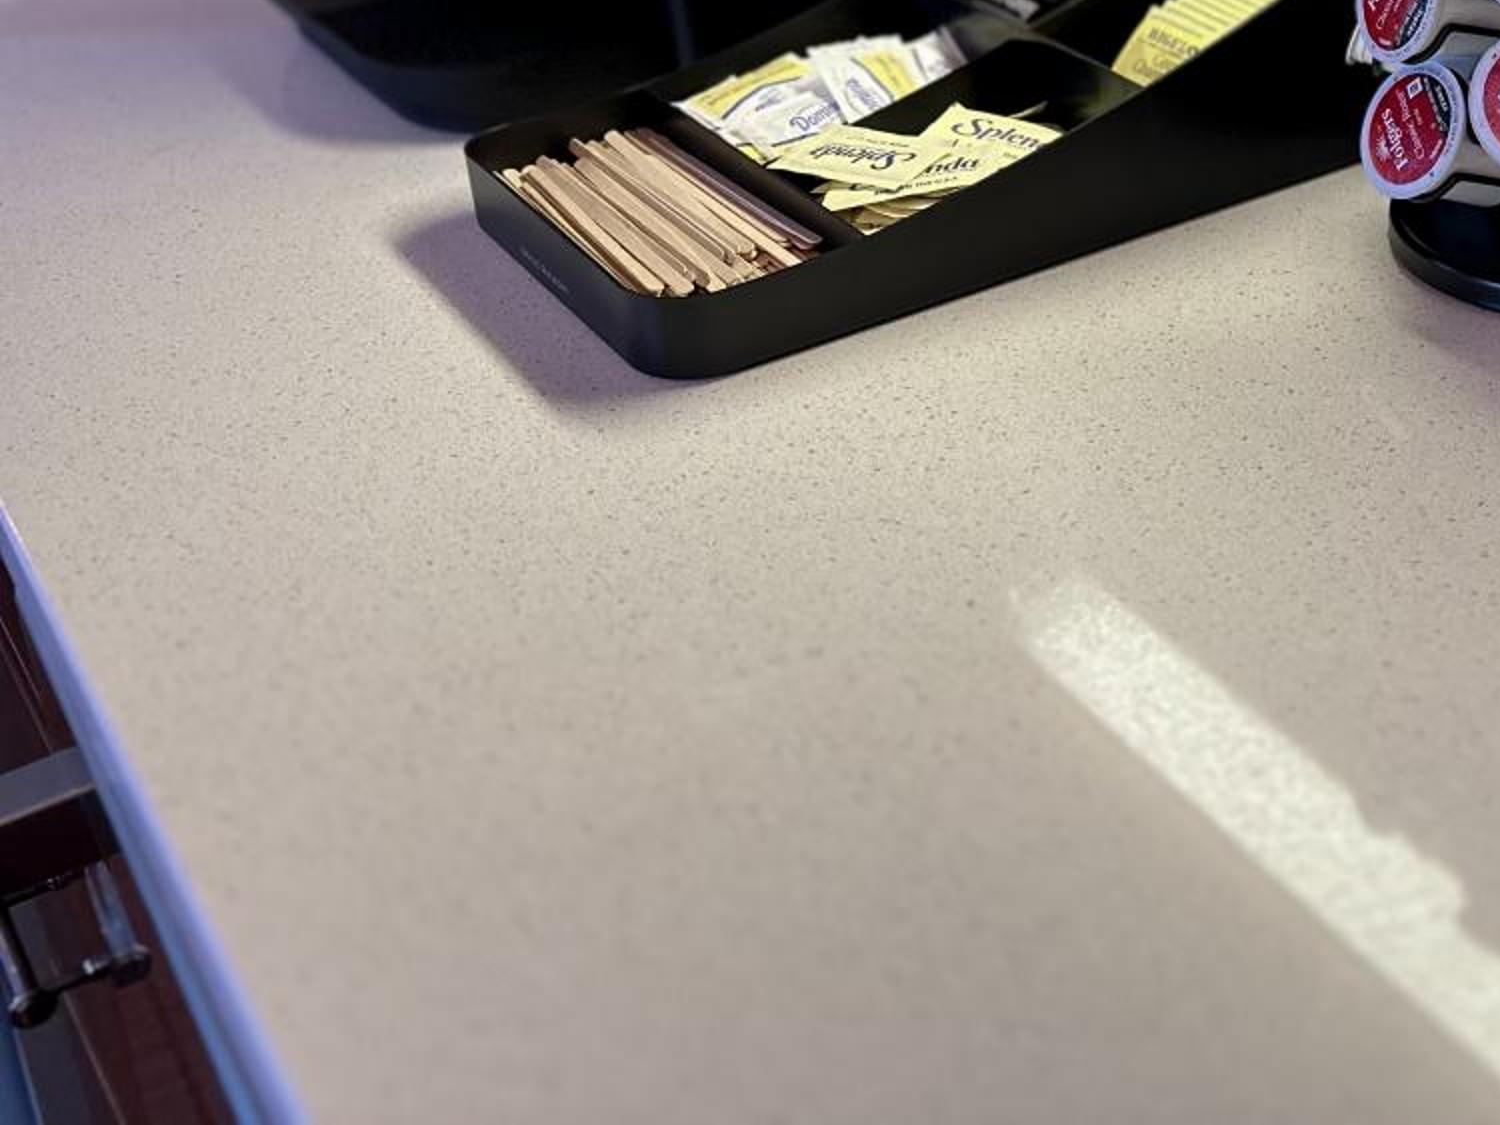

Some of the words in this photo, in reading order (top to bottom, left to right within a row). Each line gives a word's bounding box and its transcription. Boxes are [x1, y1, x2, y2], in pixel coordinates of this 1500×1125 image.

[1148, 27, 1200, 56] BIGELO
[951, 118, 1040, 149] Splen
[1381, 108, 1409, 172] Folgers
